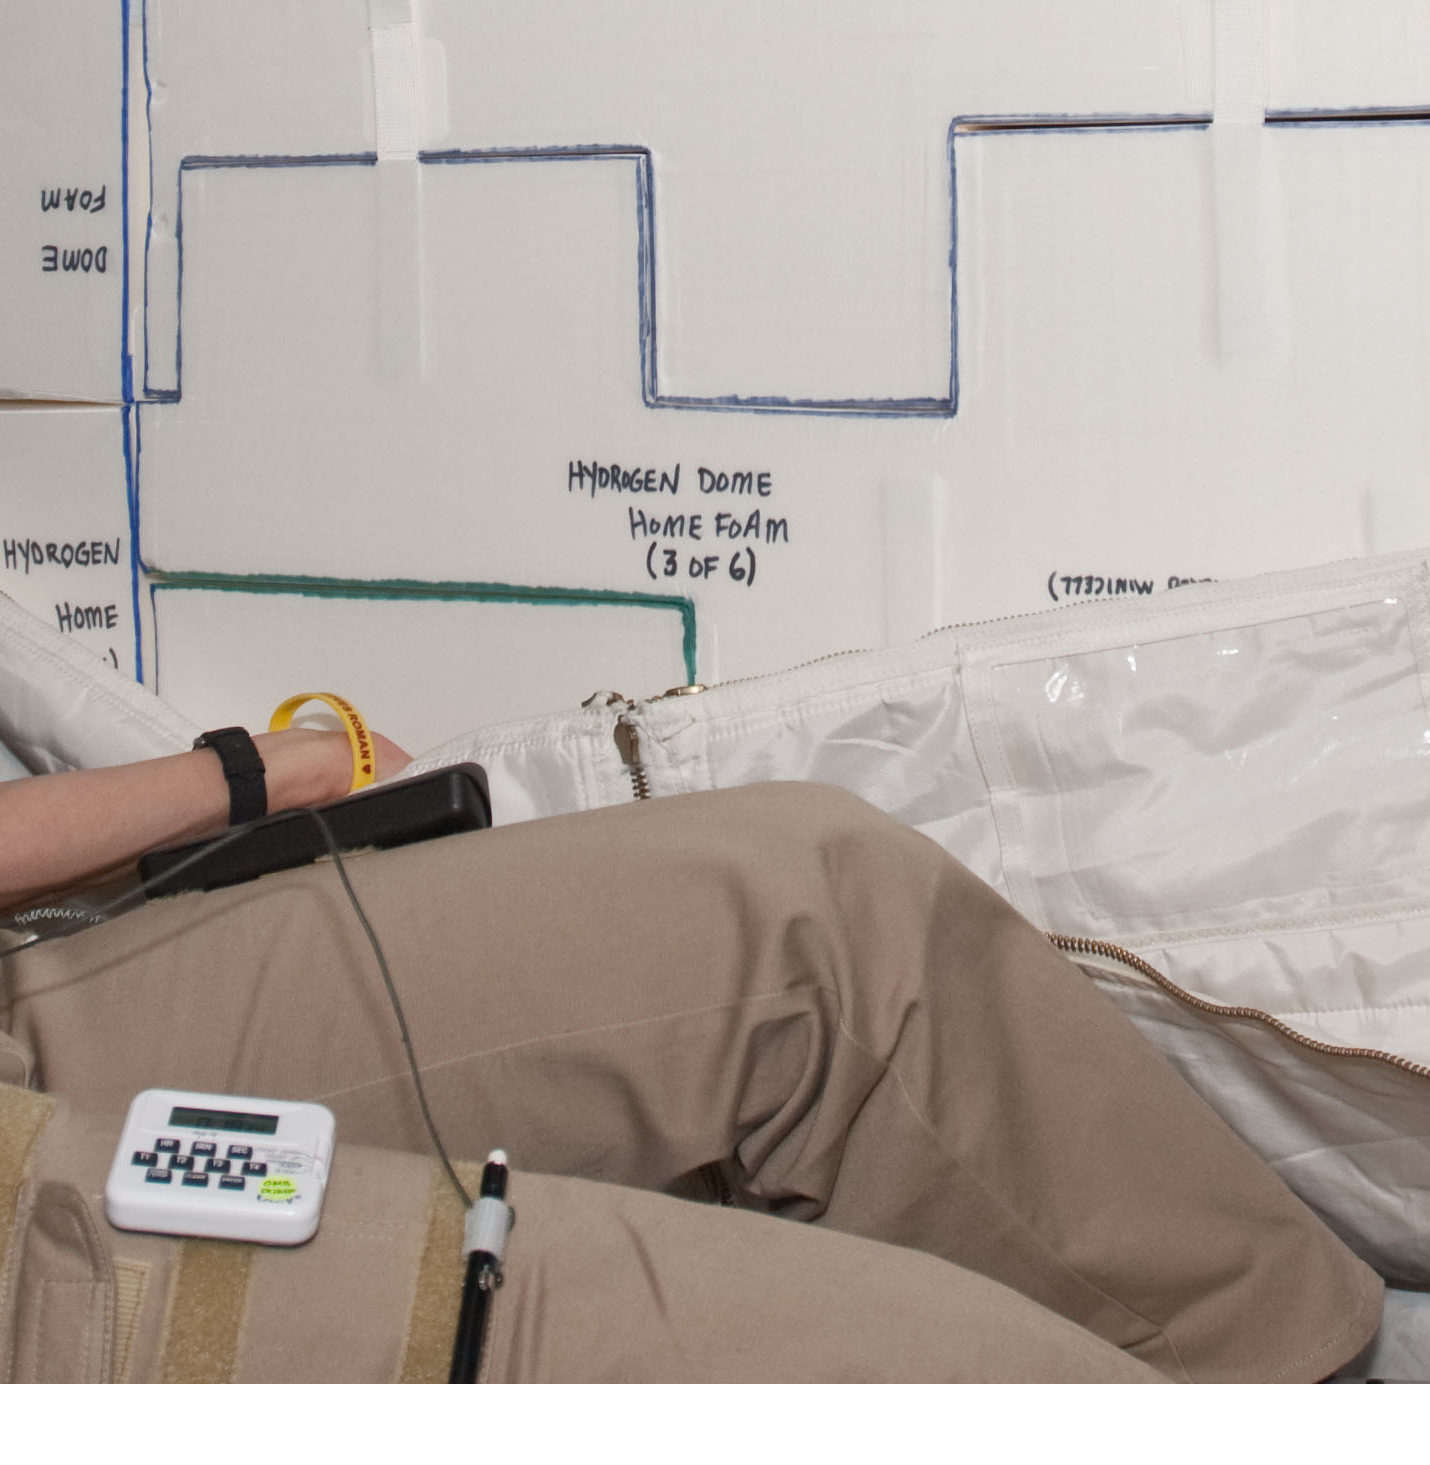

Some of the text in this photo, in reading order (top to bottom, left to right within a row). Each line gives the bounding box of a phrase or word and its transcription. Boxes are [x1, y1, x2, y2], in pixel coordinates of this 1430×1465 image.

[41, 184, 106, 213] FOAM
[41, 245, 108, 273] DOME
[569, 460, 772, 498] HYDROGEN DOME
[628, 506, 789, 543] HOME FOAM
[3, 537, 121, 574] HYDROGEN
[646, 541, 756, 587] (3 OF 6)
[55, 601, 119, 633] HOME
[349, 712, 371, 760] ROMAN
